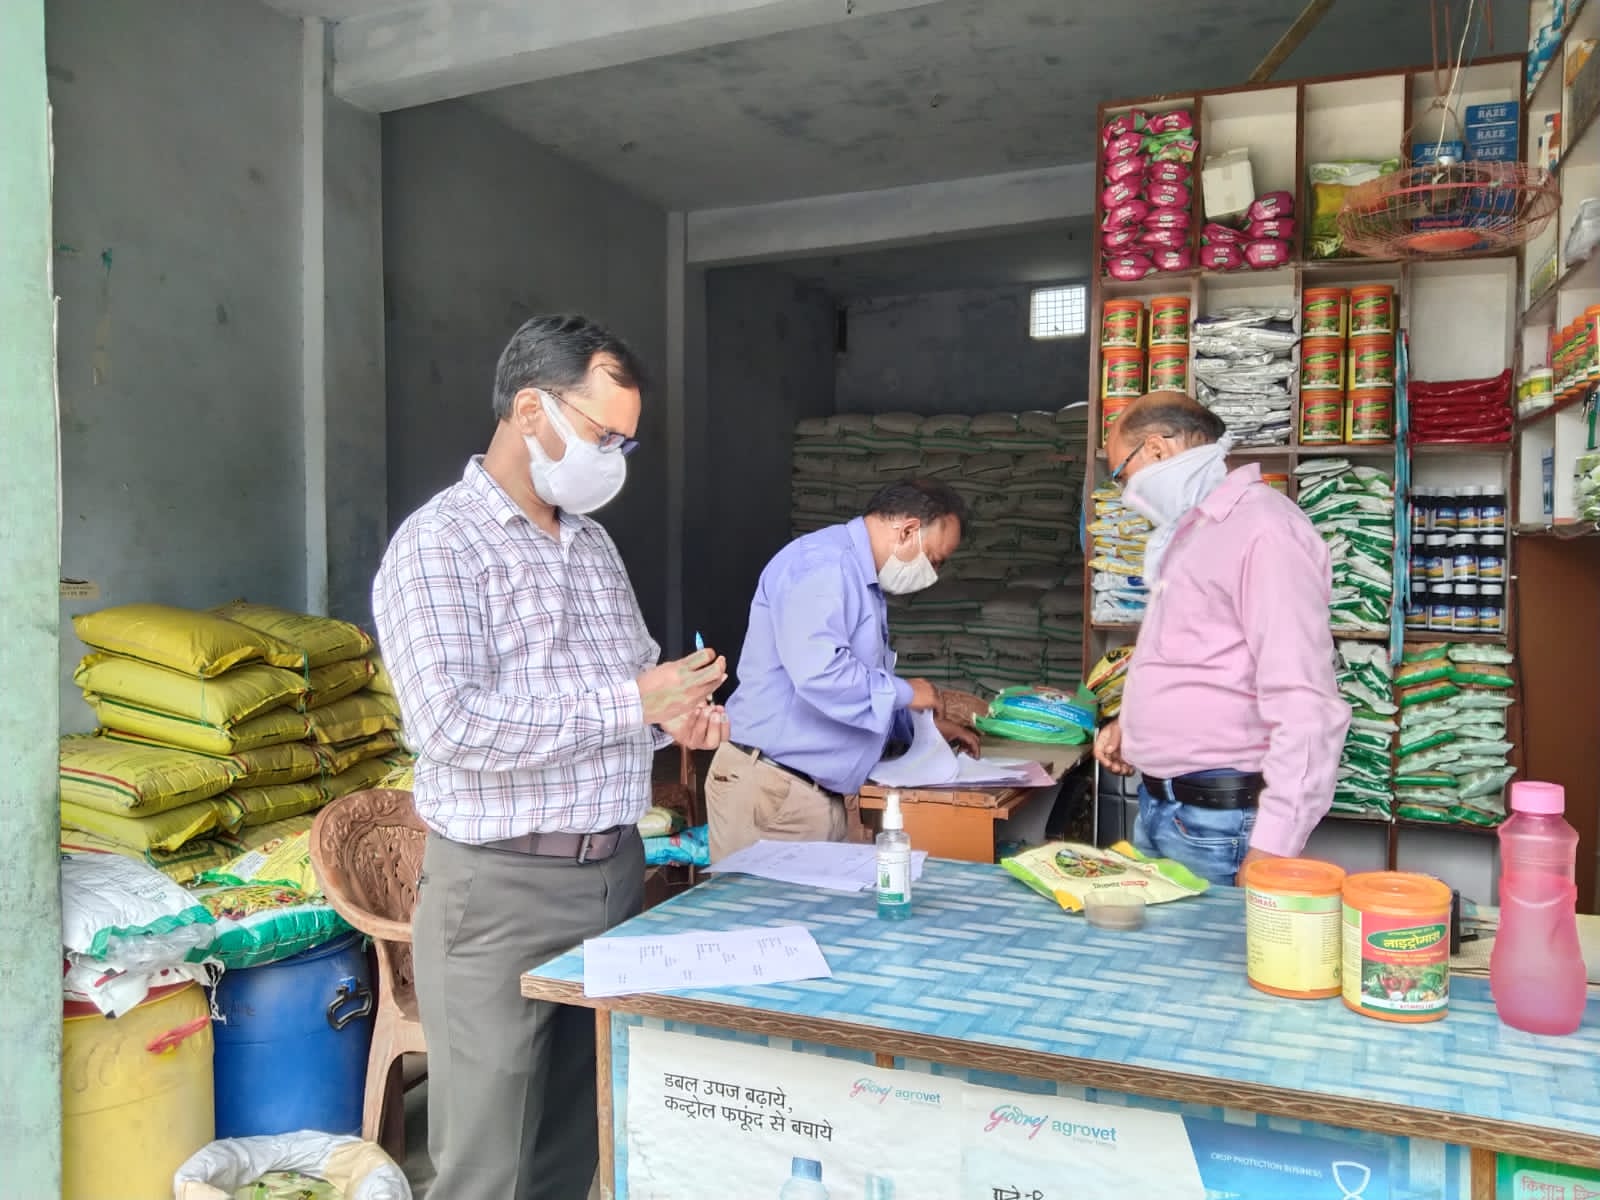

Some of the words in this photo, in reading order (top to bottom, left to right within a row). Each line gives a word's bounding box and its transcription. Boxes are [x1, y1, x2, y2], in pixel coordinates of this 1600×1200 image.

[664, 1073, 698, 1095] डबल
[703, 1079, 741, 1101] उपज
[895, 1088, 941, 1104] agrovet
[664, 1096, 716, 1119] कन्ट्रोल
[721, 1104, 765, 1131] फफूंद
[770, 1110, 786, 1133] से
[791, 1119, 833, 1142] बचाये
[984, 1104, 1048, 1140] Godrej
[1052, 1118, 1117, 1142] agrovet
